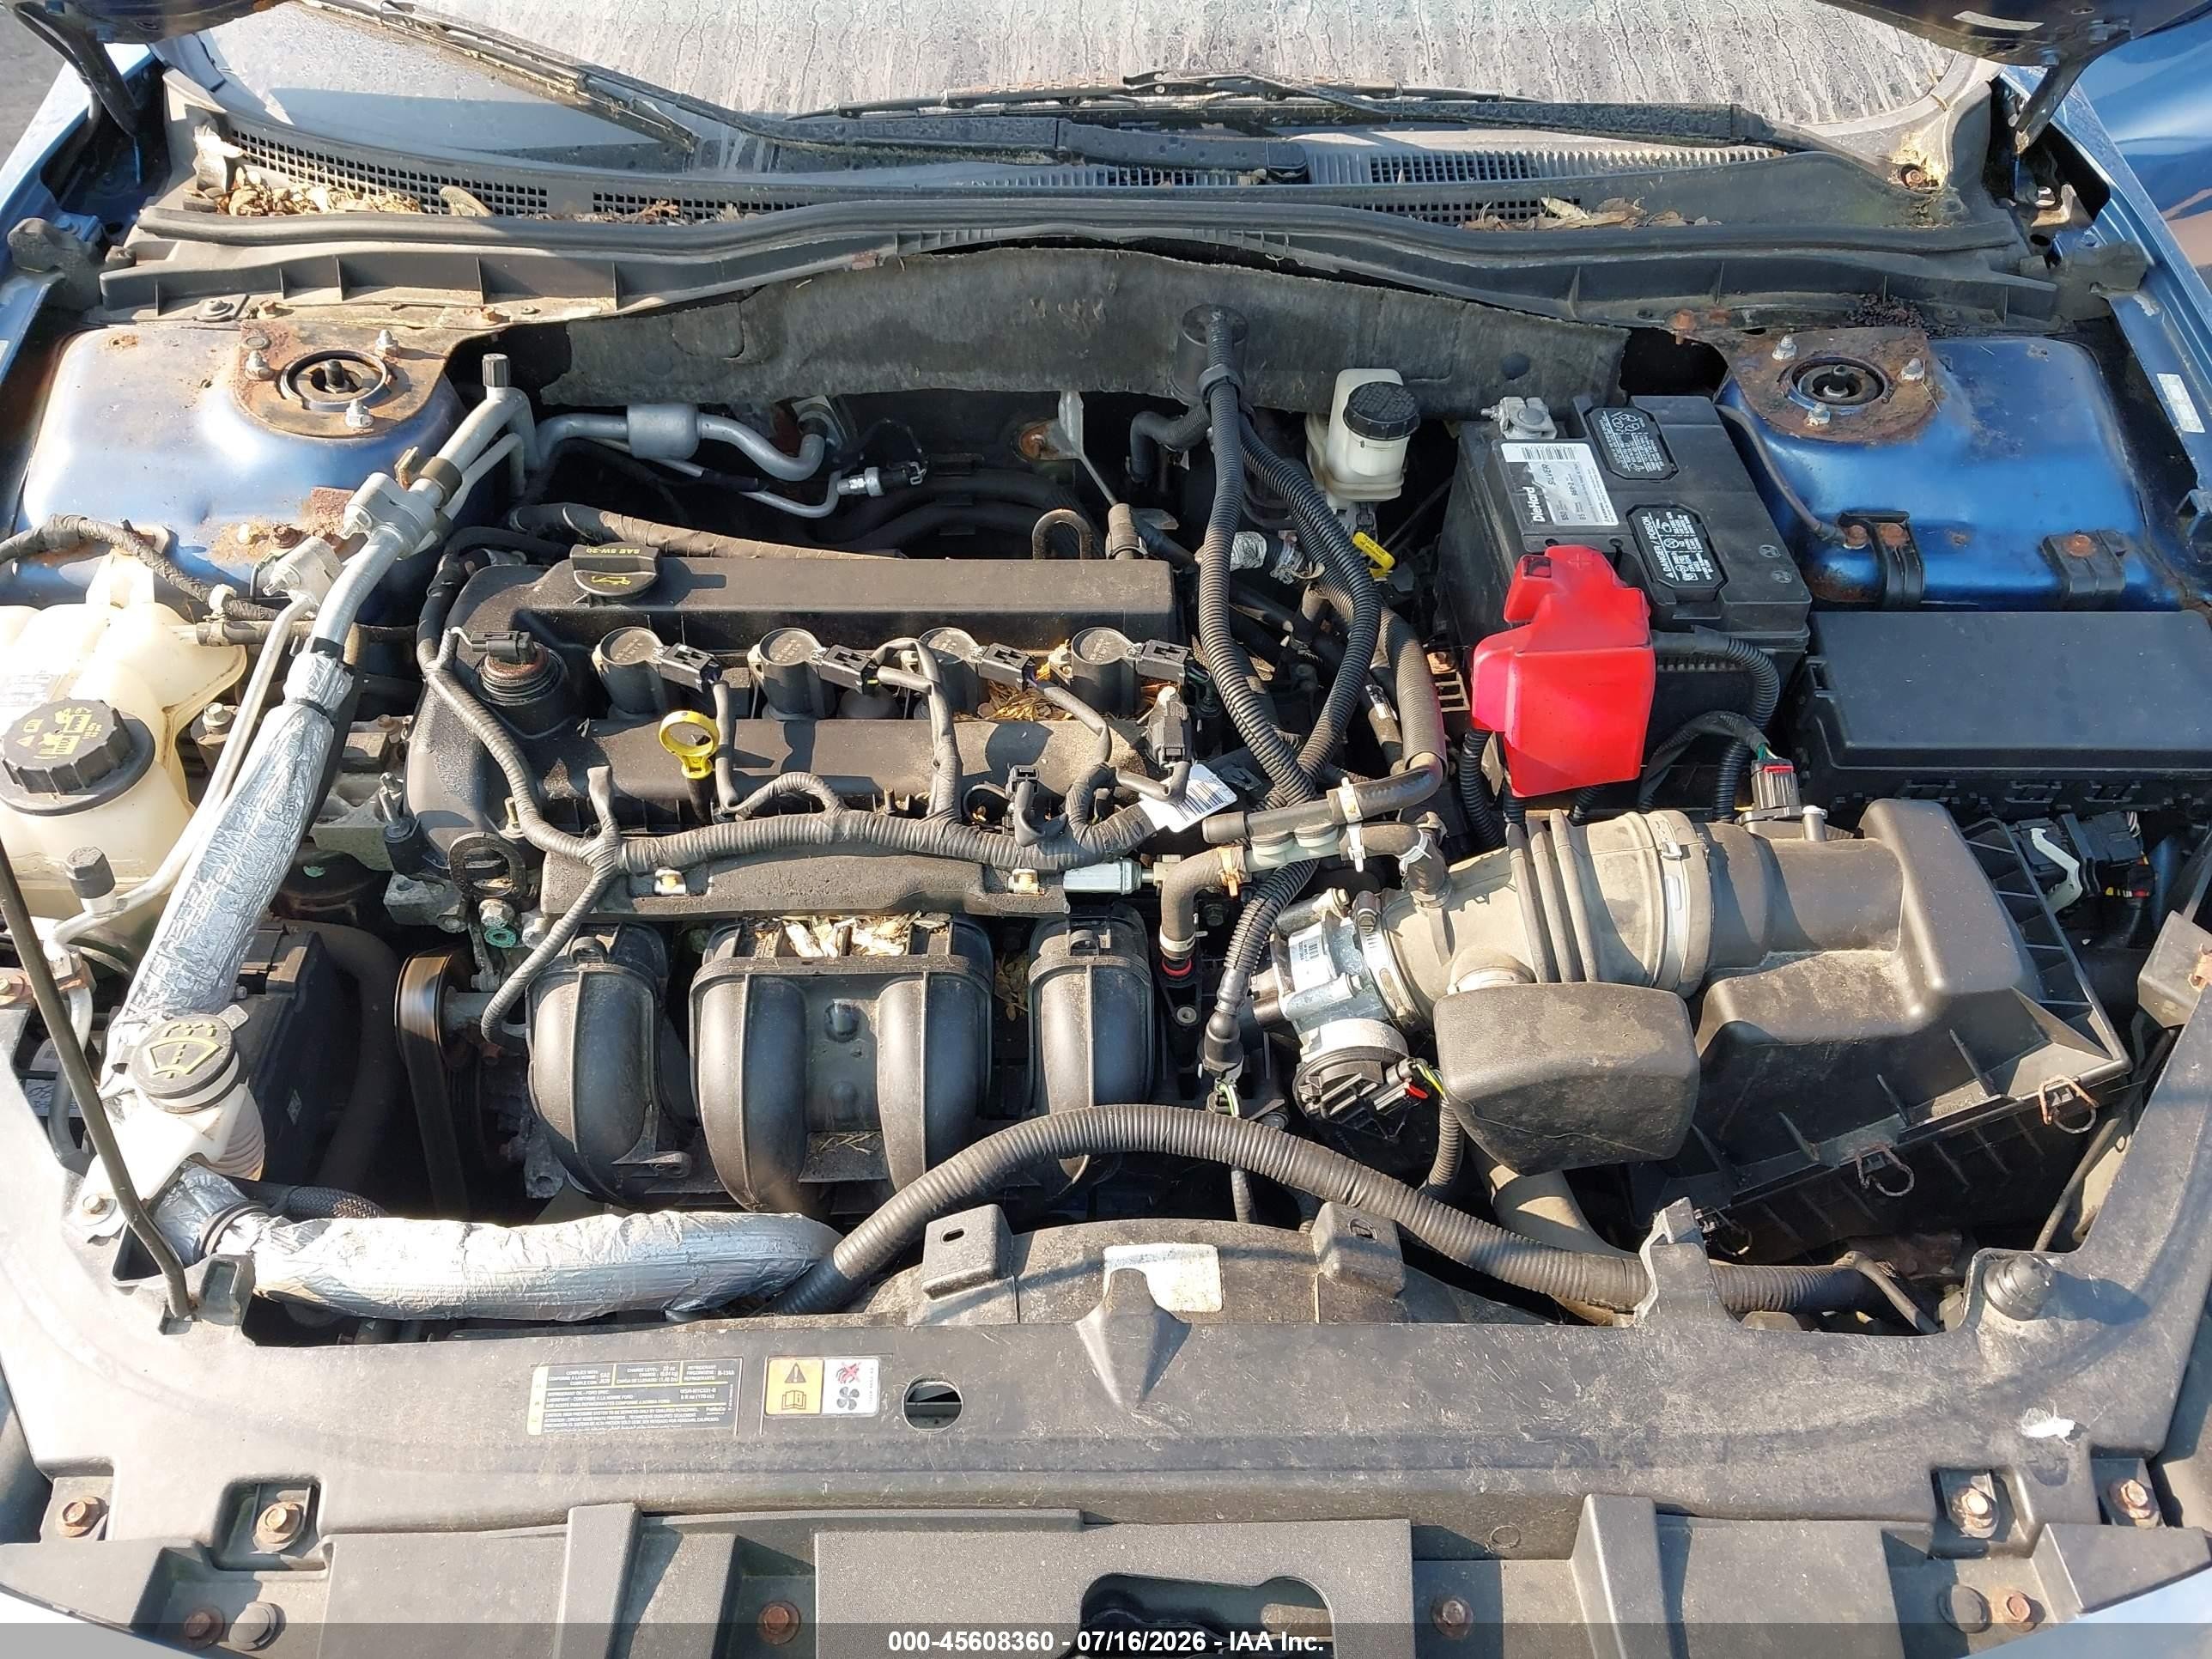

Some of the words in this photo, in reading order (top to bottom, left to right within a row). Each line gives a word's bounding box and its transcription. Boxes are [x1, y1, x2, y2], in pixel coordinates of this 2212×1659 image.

[1540, 463, 1557, 486] SILVER
[1522, 486, 1546, 523] DieHard
[1642, 516, 1658, 539] POISON
[1653, 545, 1671, 572] DANGER
